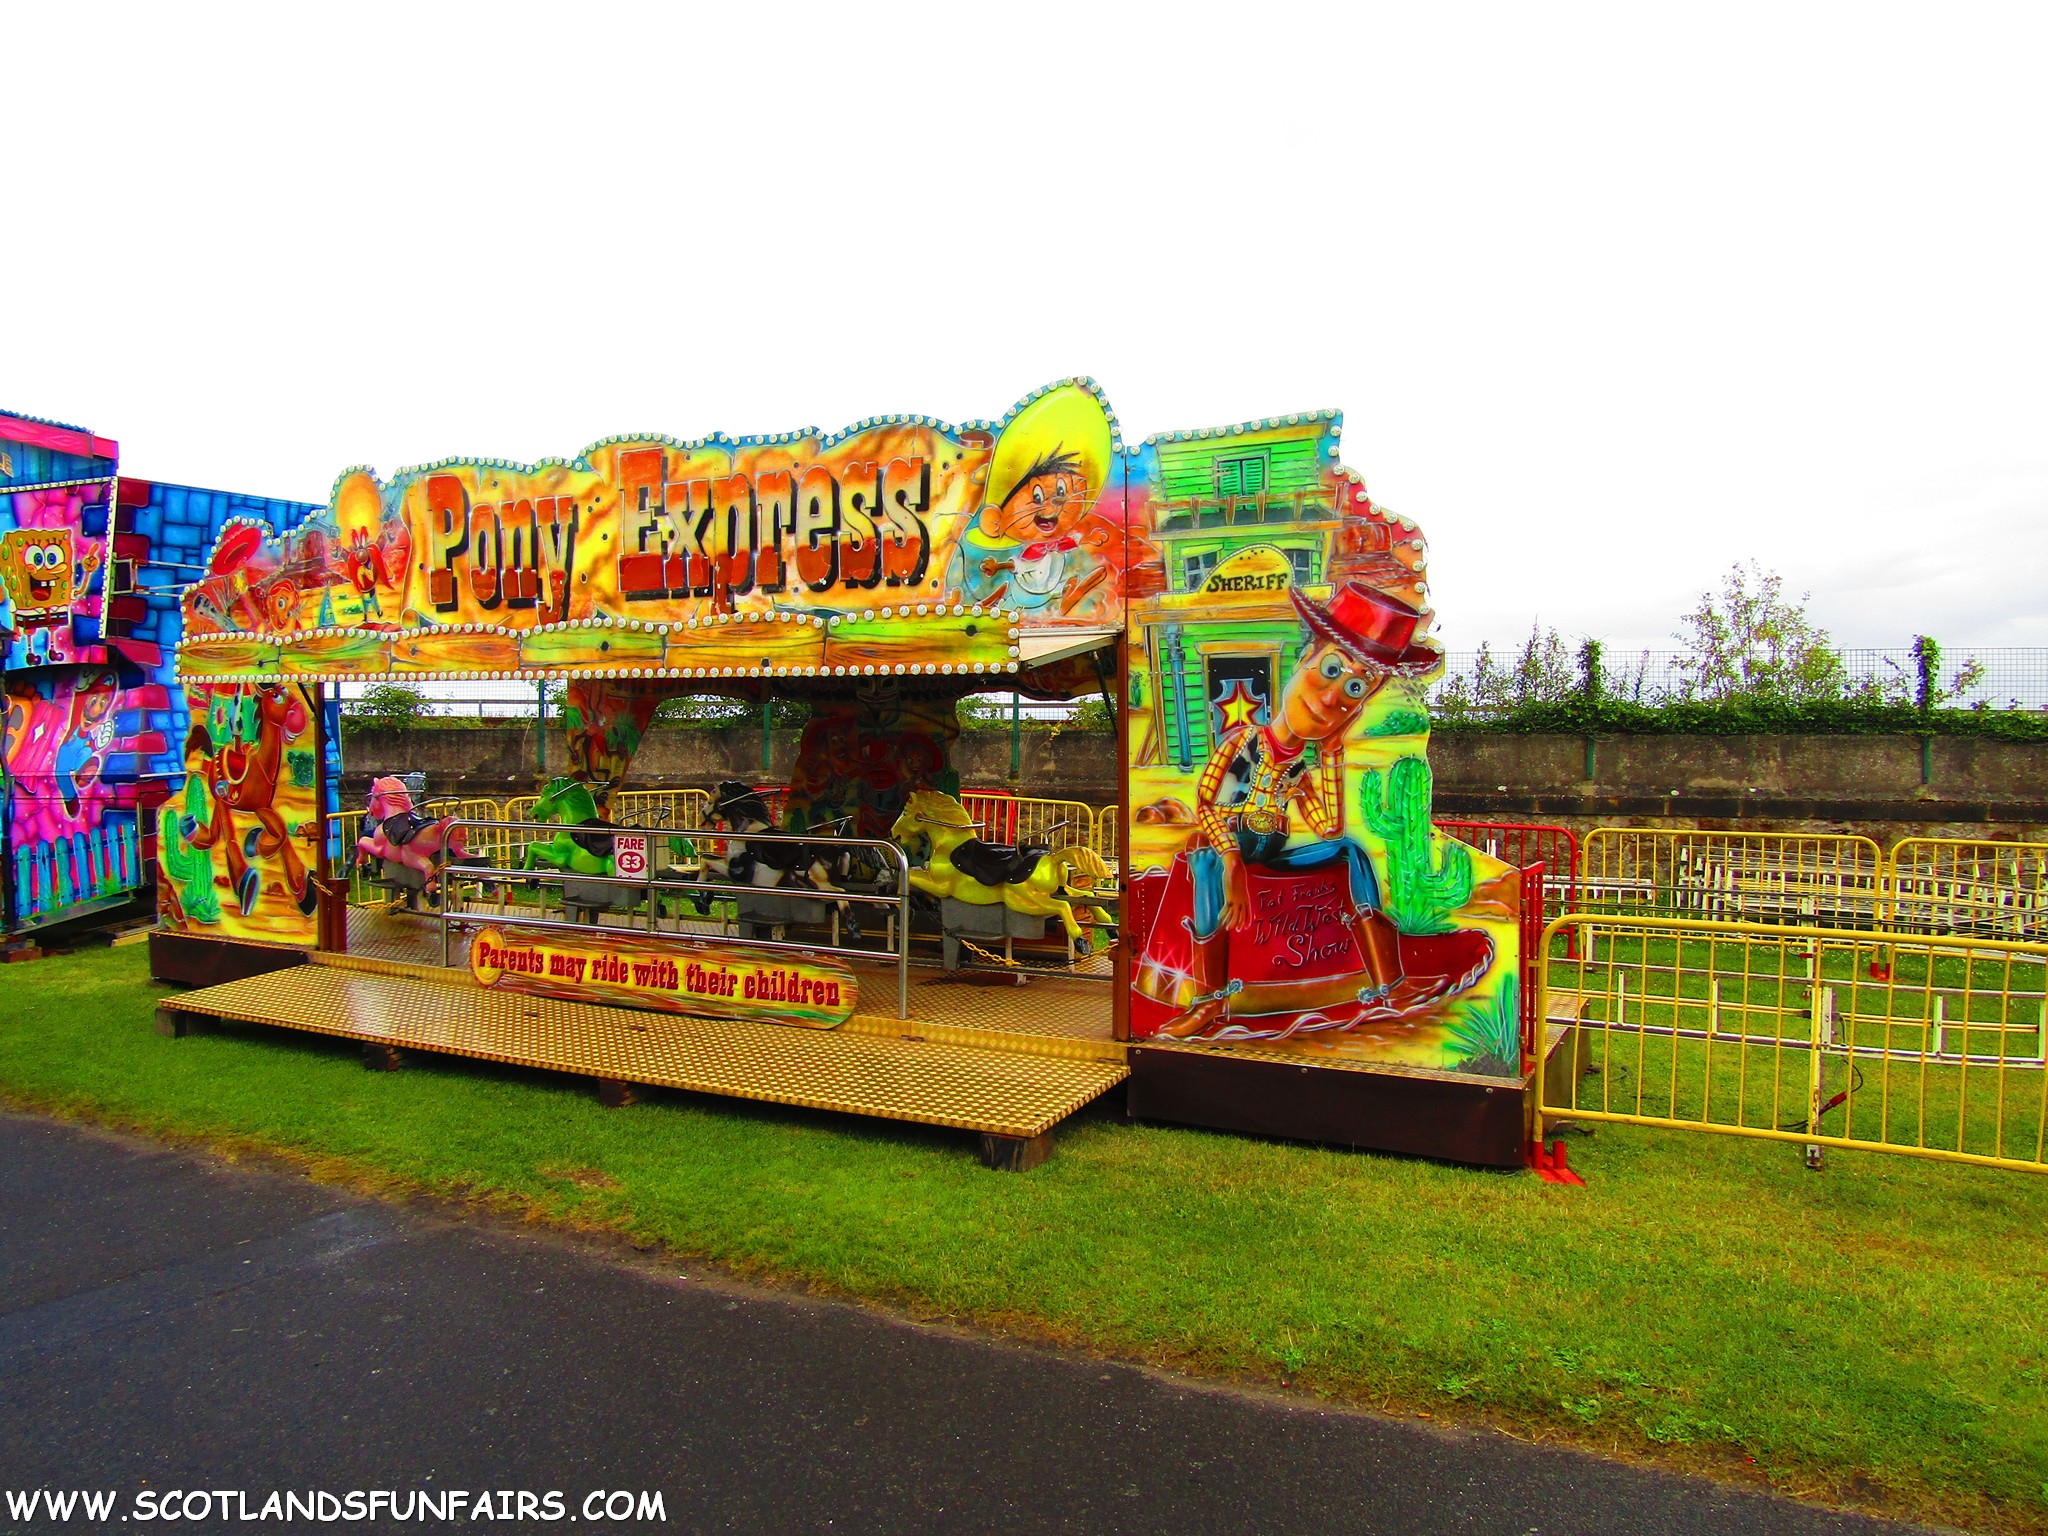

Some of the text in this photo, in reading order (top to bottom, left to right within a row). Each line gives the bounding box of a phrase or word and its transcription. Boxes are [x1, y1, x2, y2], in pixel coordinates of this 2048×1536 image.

[426, 447, 930, 625] Pony Express
[1206, 573, 1288, 592] SHERIFF
[617, 837, 645, 850] FARE
[621, 854, 641, 869] £3
[1257, 889, 1284, 909] Fat
[1253, 897, 1345, 944] Wild West
[1271, 934, 1351, 967] Show
[478, 942, 841, 1006] Parents may ride with their children
